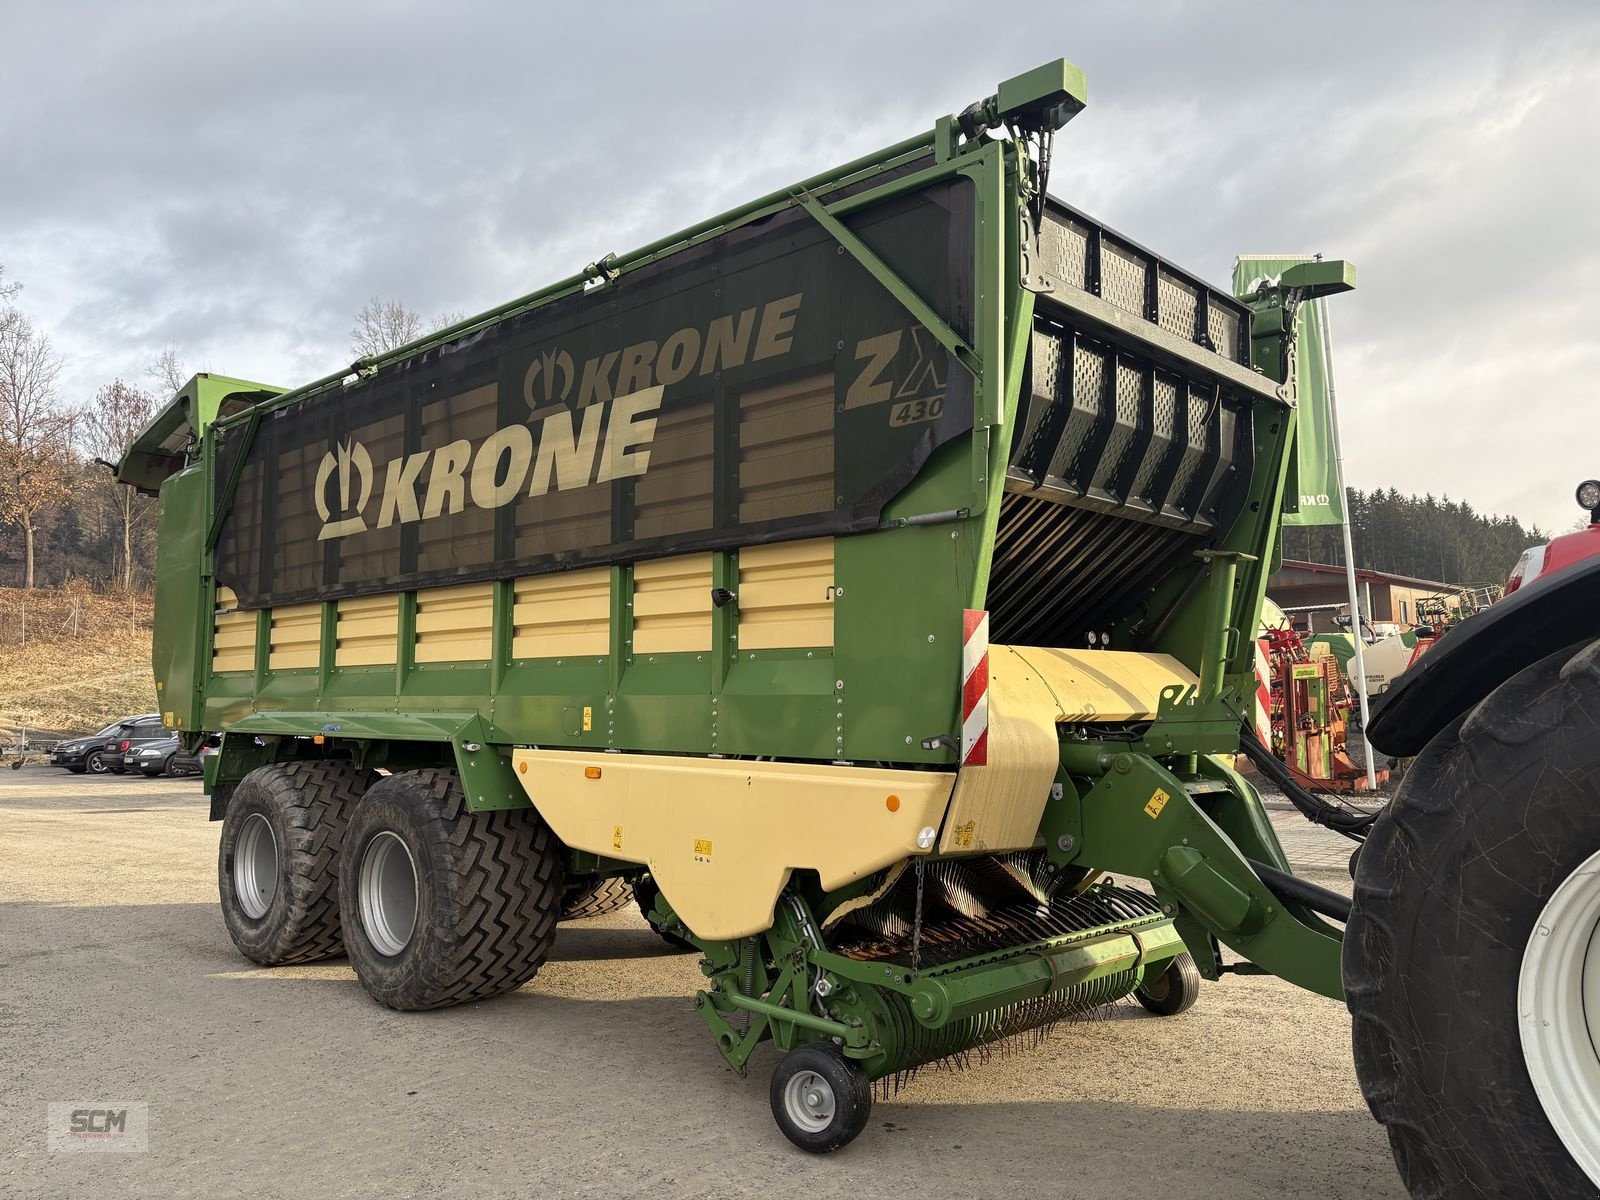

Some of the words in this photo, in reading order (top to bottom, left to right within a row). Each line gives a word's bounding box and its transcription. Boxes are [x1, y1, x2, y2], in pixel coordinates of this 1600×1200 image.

[577, 293, 803, 409] KRONE
[844, 324, 948, 410] ZX
[377, 384, 665, 529] KRONE
[895, 398, 945, 423] 430
